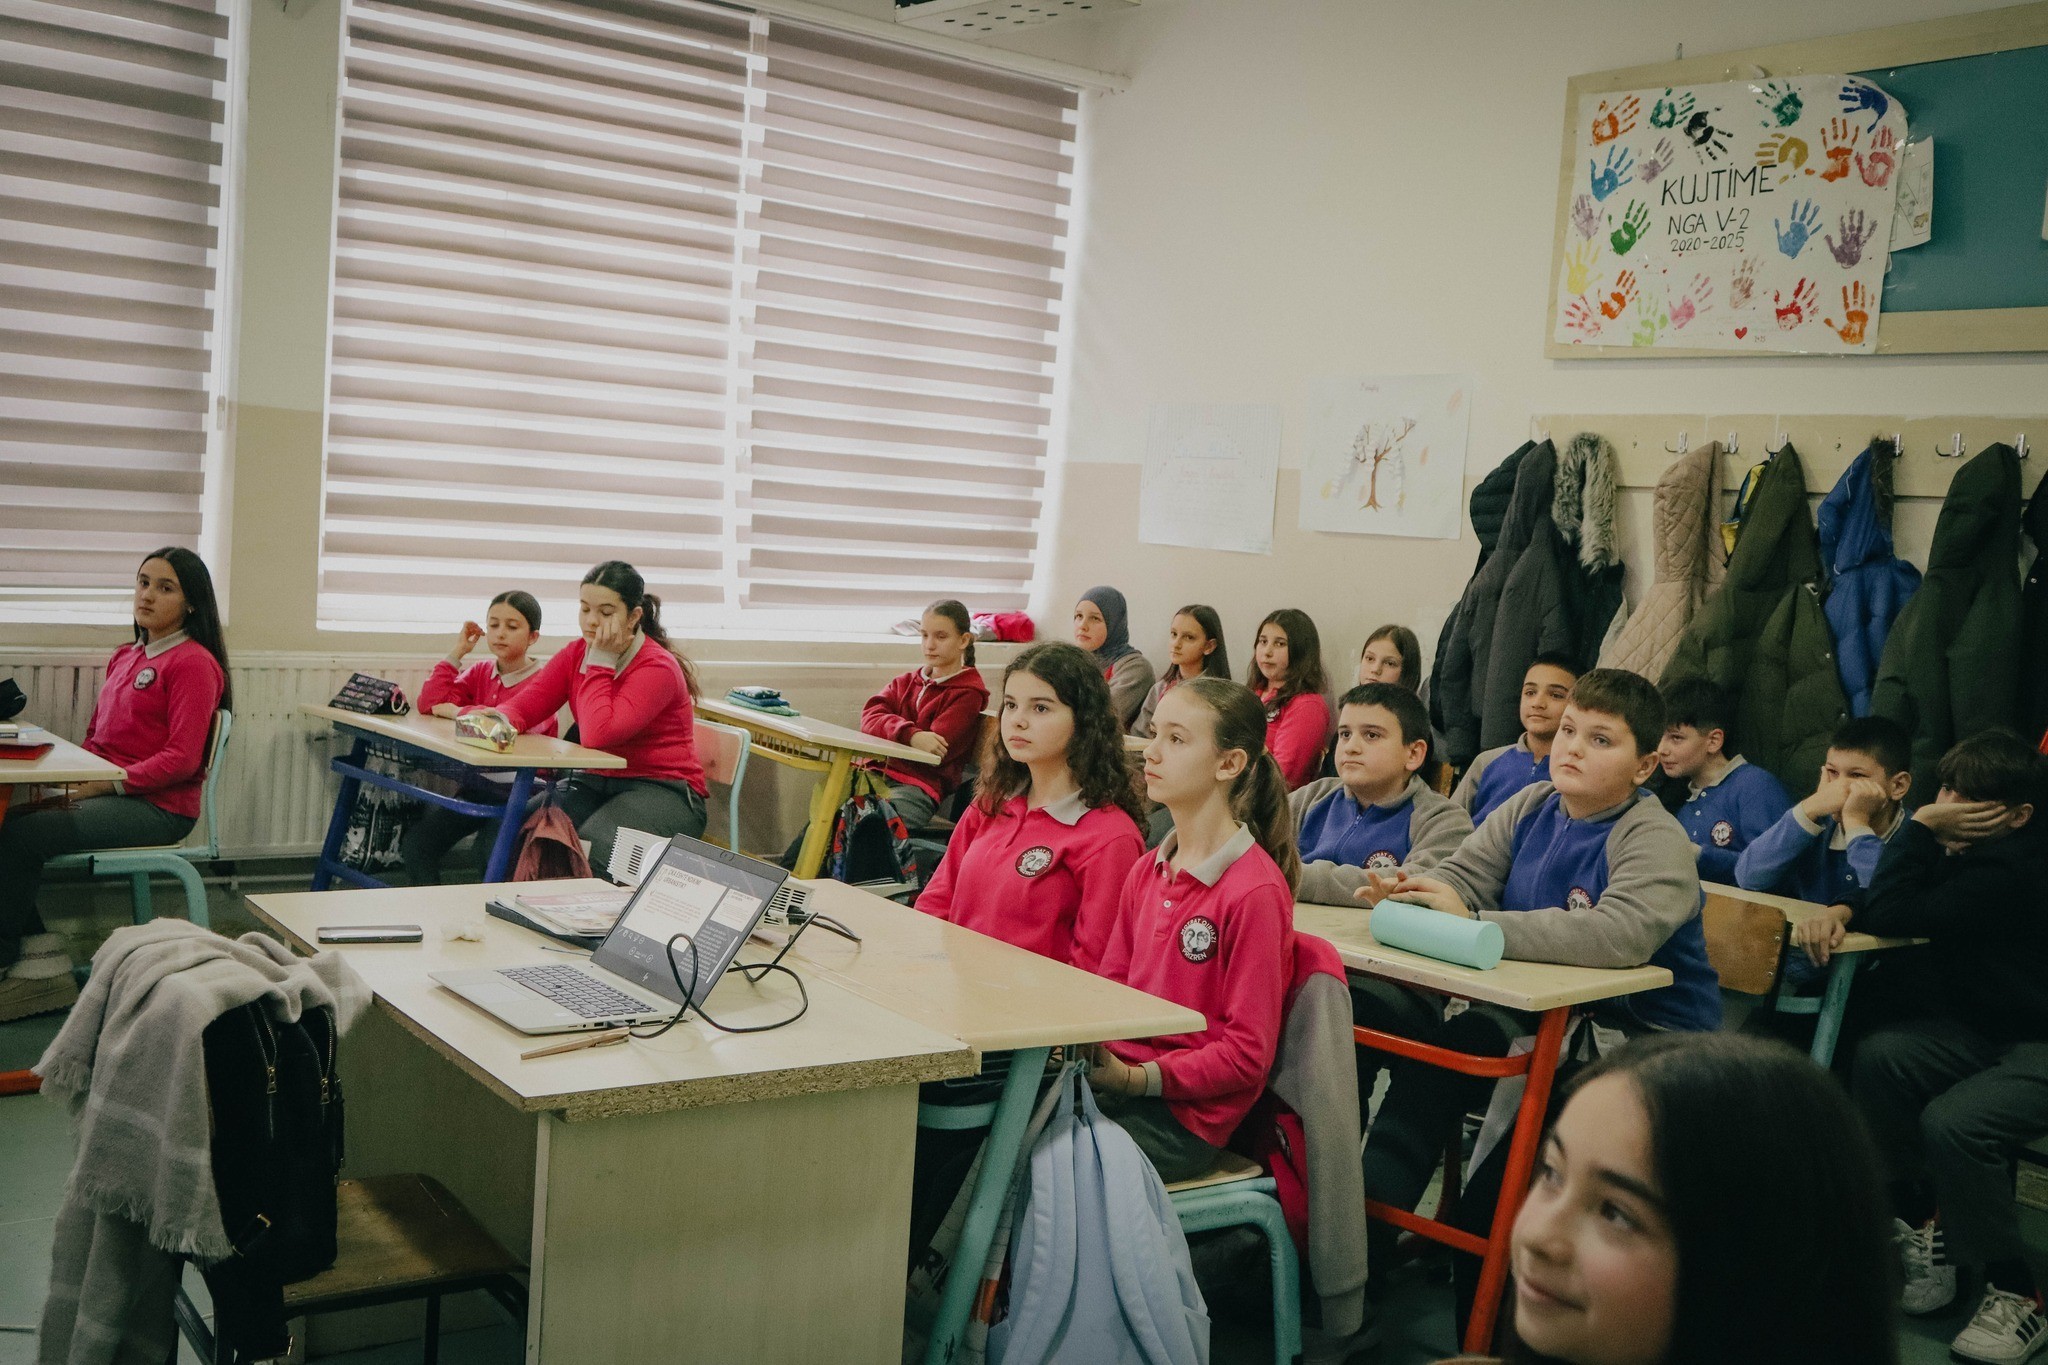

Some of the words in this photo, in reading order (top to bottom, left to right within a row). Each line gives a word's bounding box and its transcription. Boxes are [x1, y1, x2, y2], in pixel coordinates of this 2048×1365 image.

[1668, 213, 1707, 235] NGA
[1716, 207, 1750, 231] V-2
[1670, 231, 1745, 252] 2020-2025
[1182, 949, 1206, 961] PRIZREN
